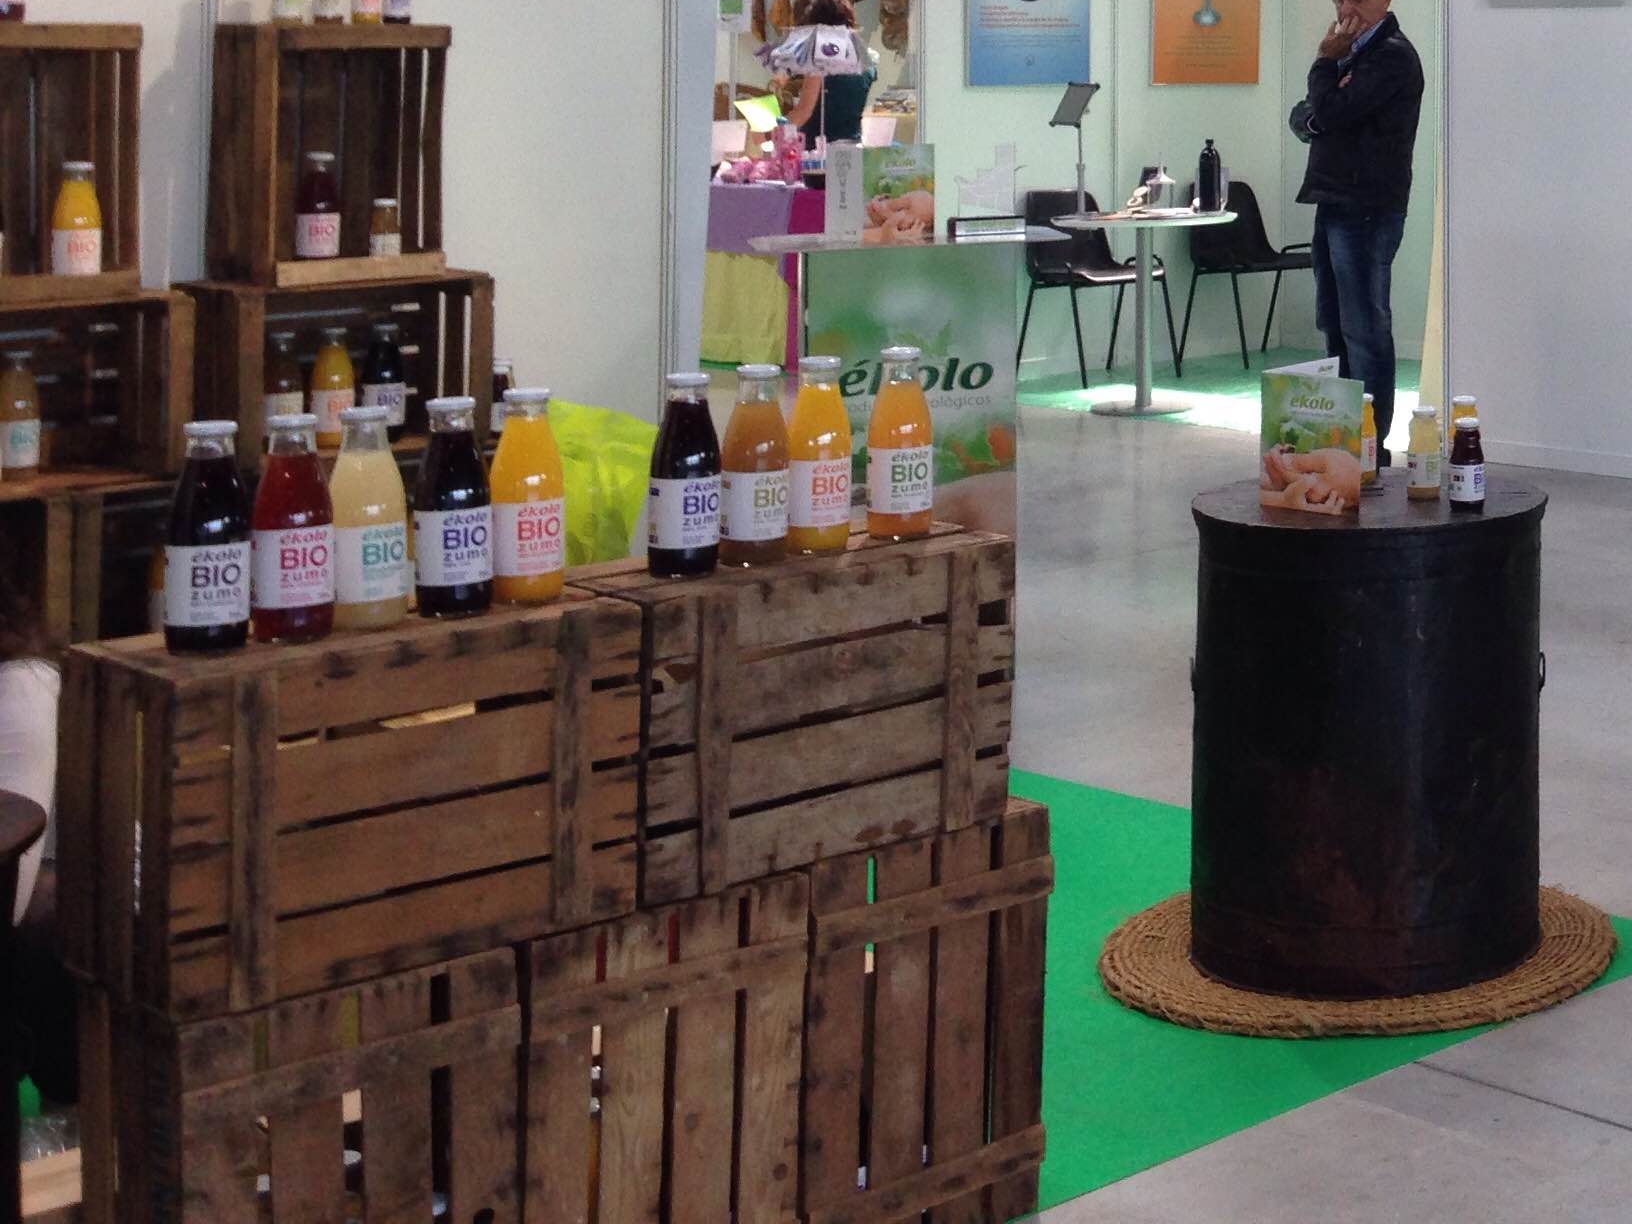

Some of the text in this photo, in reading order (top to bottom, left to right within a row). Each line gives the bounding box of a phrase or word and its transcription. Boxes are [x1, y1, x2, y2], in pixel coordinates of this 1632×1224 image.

[891, 462, 928, 483] BIO
[811, 474, 849, 496] BIO
[683, 493, 720, 515] BIO
[442, 526, 488, 550] BIO
[517, 516, 561, 541] BIO
[279, 544, 328, 570] BIO
[362, 541, 404, 566] BIO
[190, 561, 242, 588] BIO
